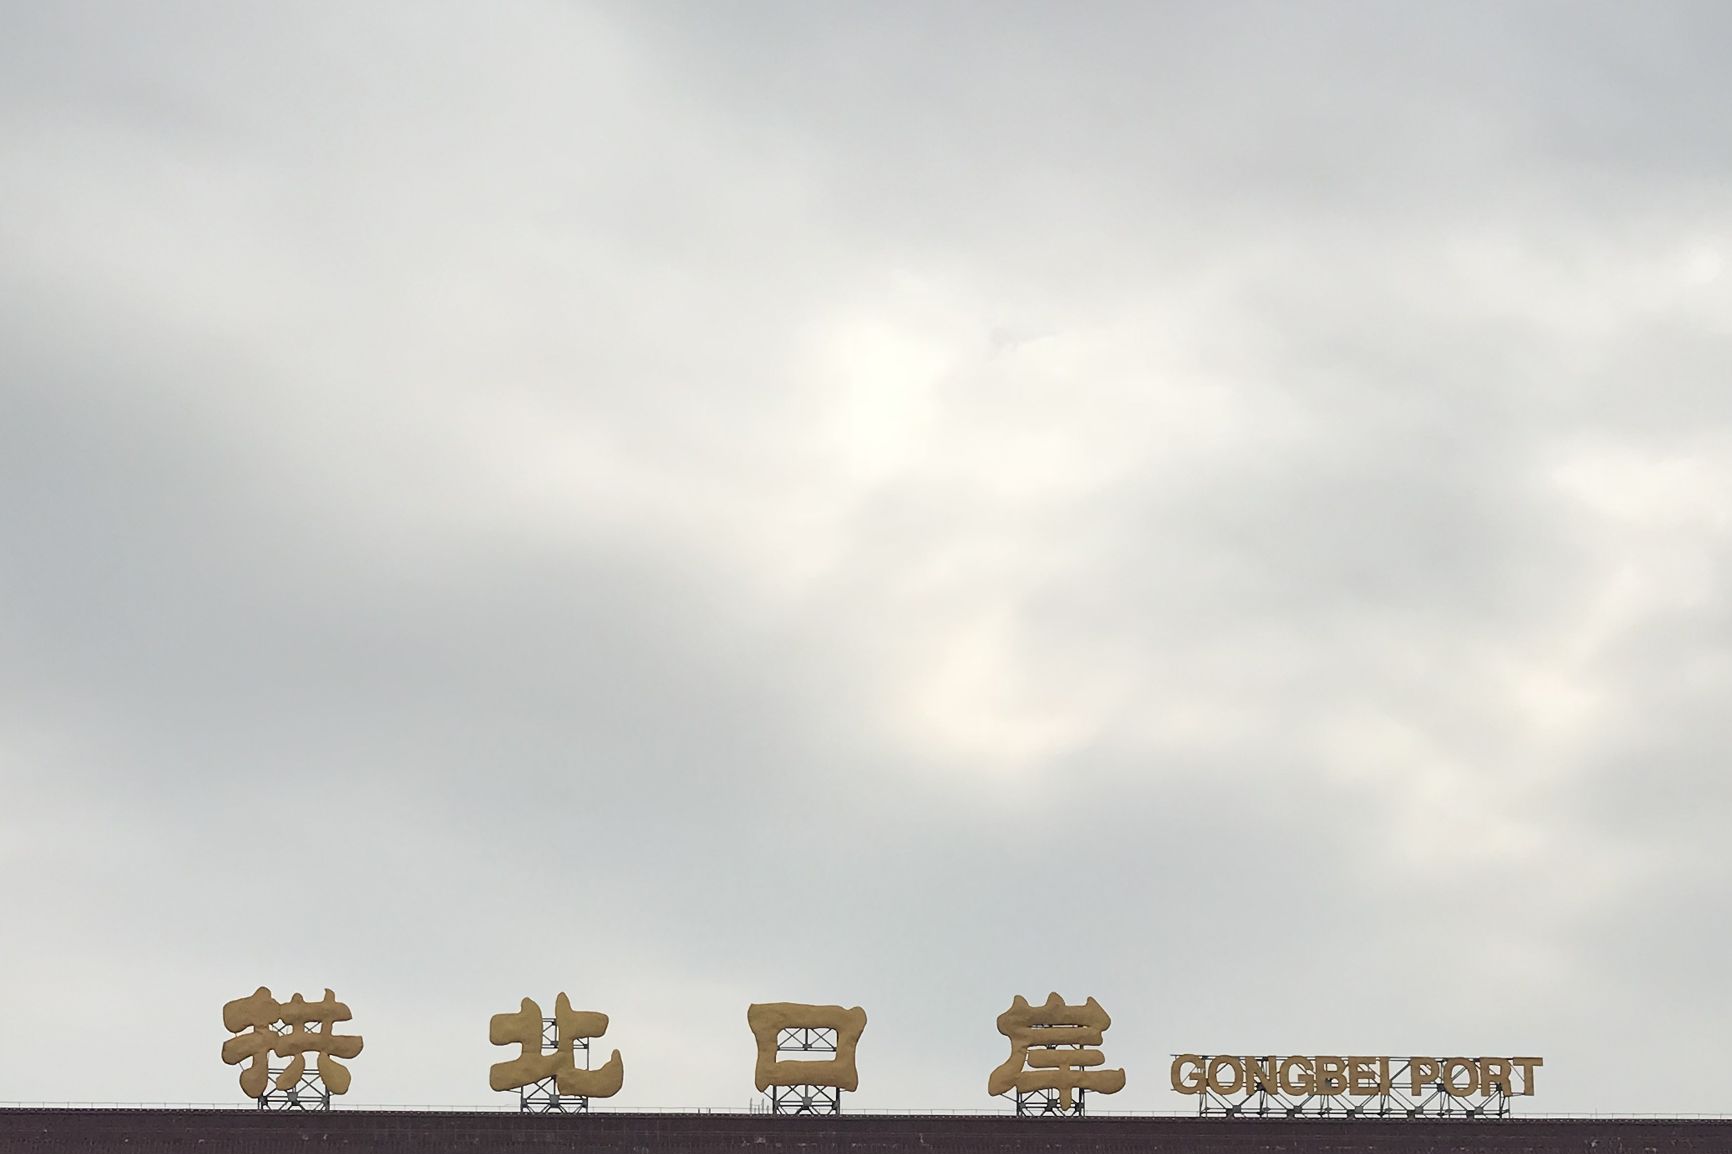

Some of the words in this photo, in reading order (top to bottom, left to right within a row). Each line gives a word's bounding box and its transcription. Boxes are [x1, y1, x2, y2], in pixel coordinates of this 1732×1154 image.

[222, 986, 1126, 1110] 拱北口岸
[1171, 1053, 1389, 1096] GONGBEI
[1409, 1057, 1543, 1097] PORT
